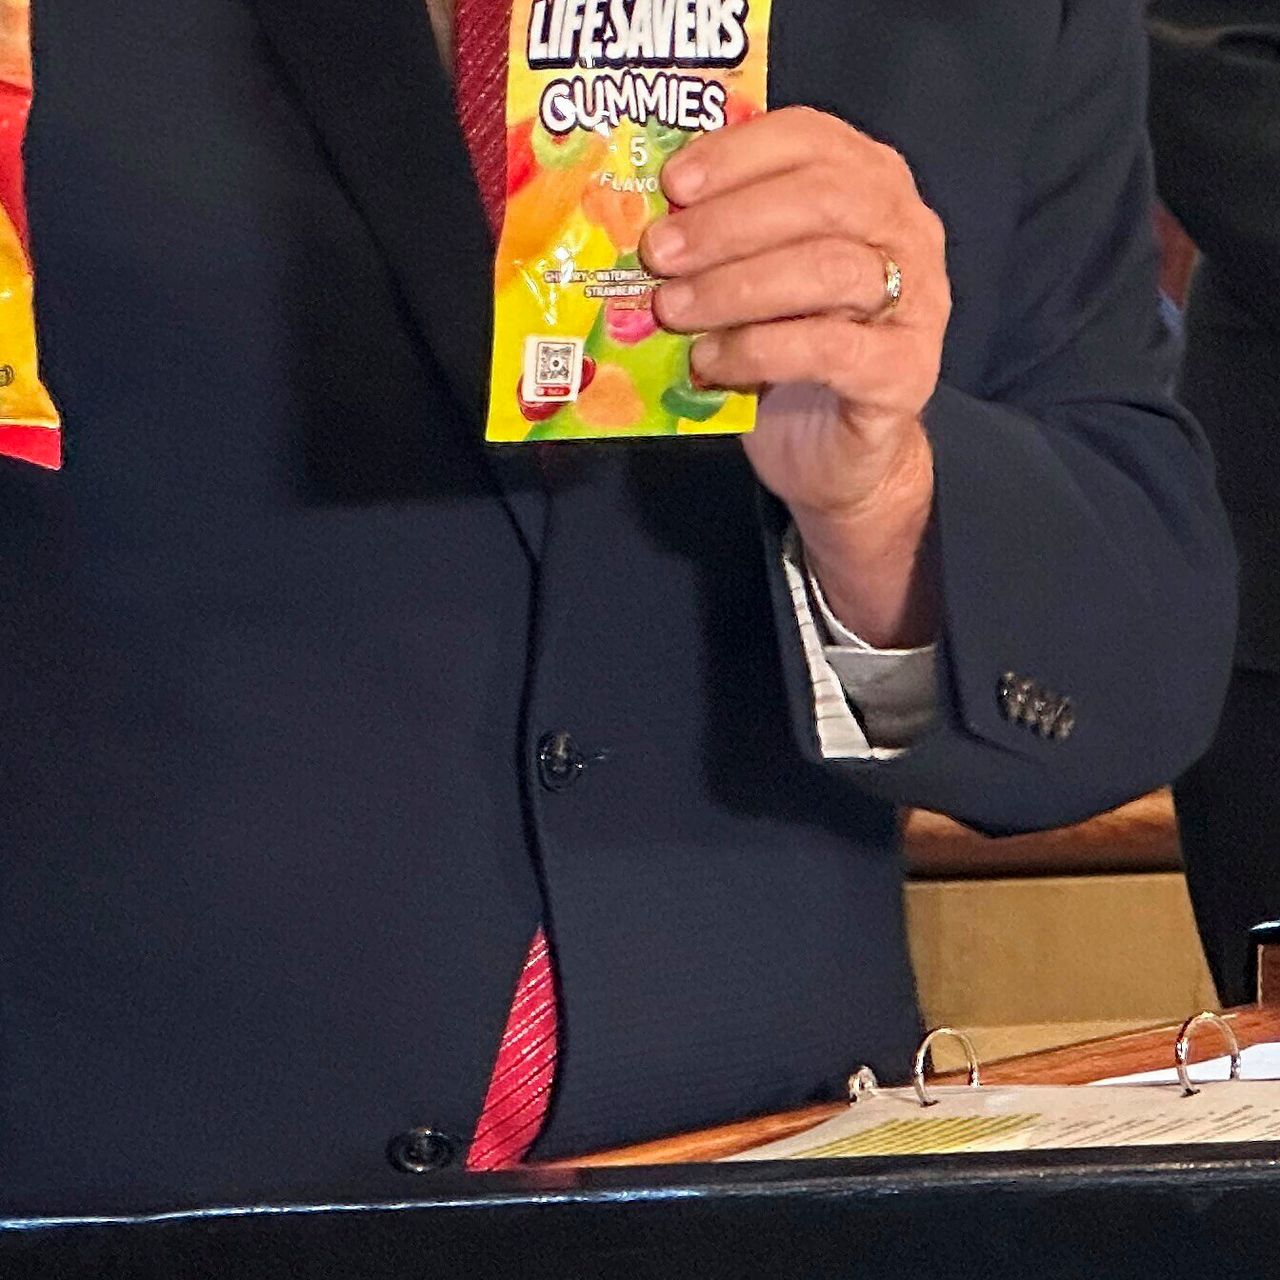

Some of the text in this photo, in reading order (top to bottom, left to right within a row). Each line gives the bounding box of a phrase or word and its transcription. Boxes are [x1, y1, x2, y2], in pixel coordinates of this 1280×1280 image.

[541, 74, 726, 132] GUMMIES
[631, 135, 649, 167] 5
[599, 172, 659, 193] FLAVO
